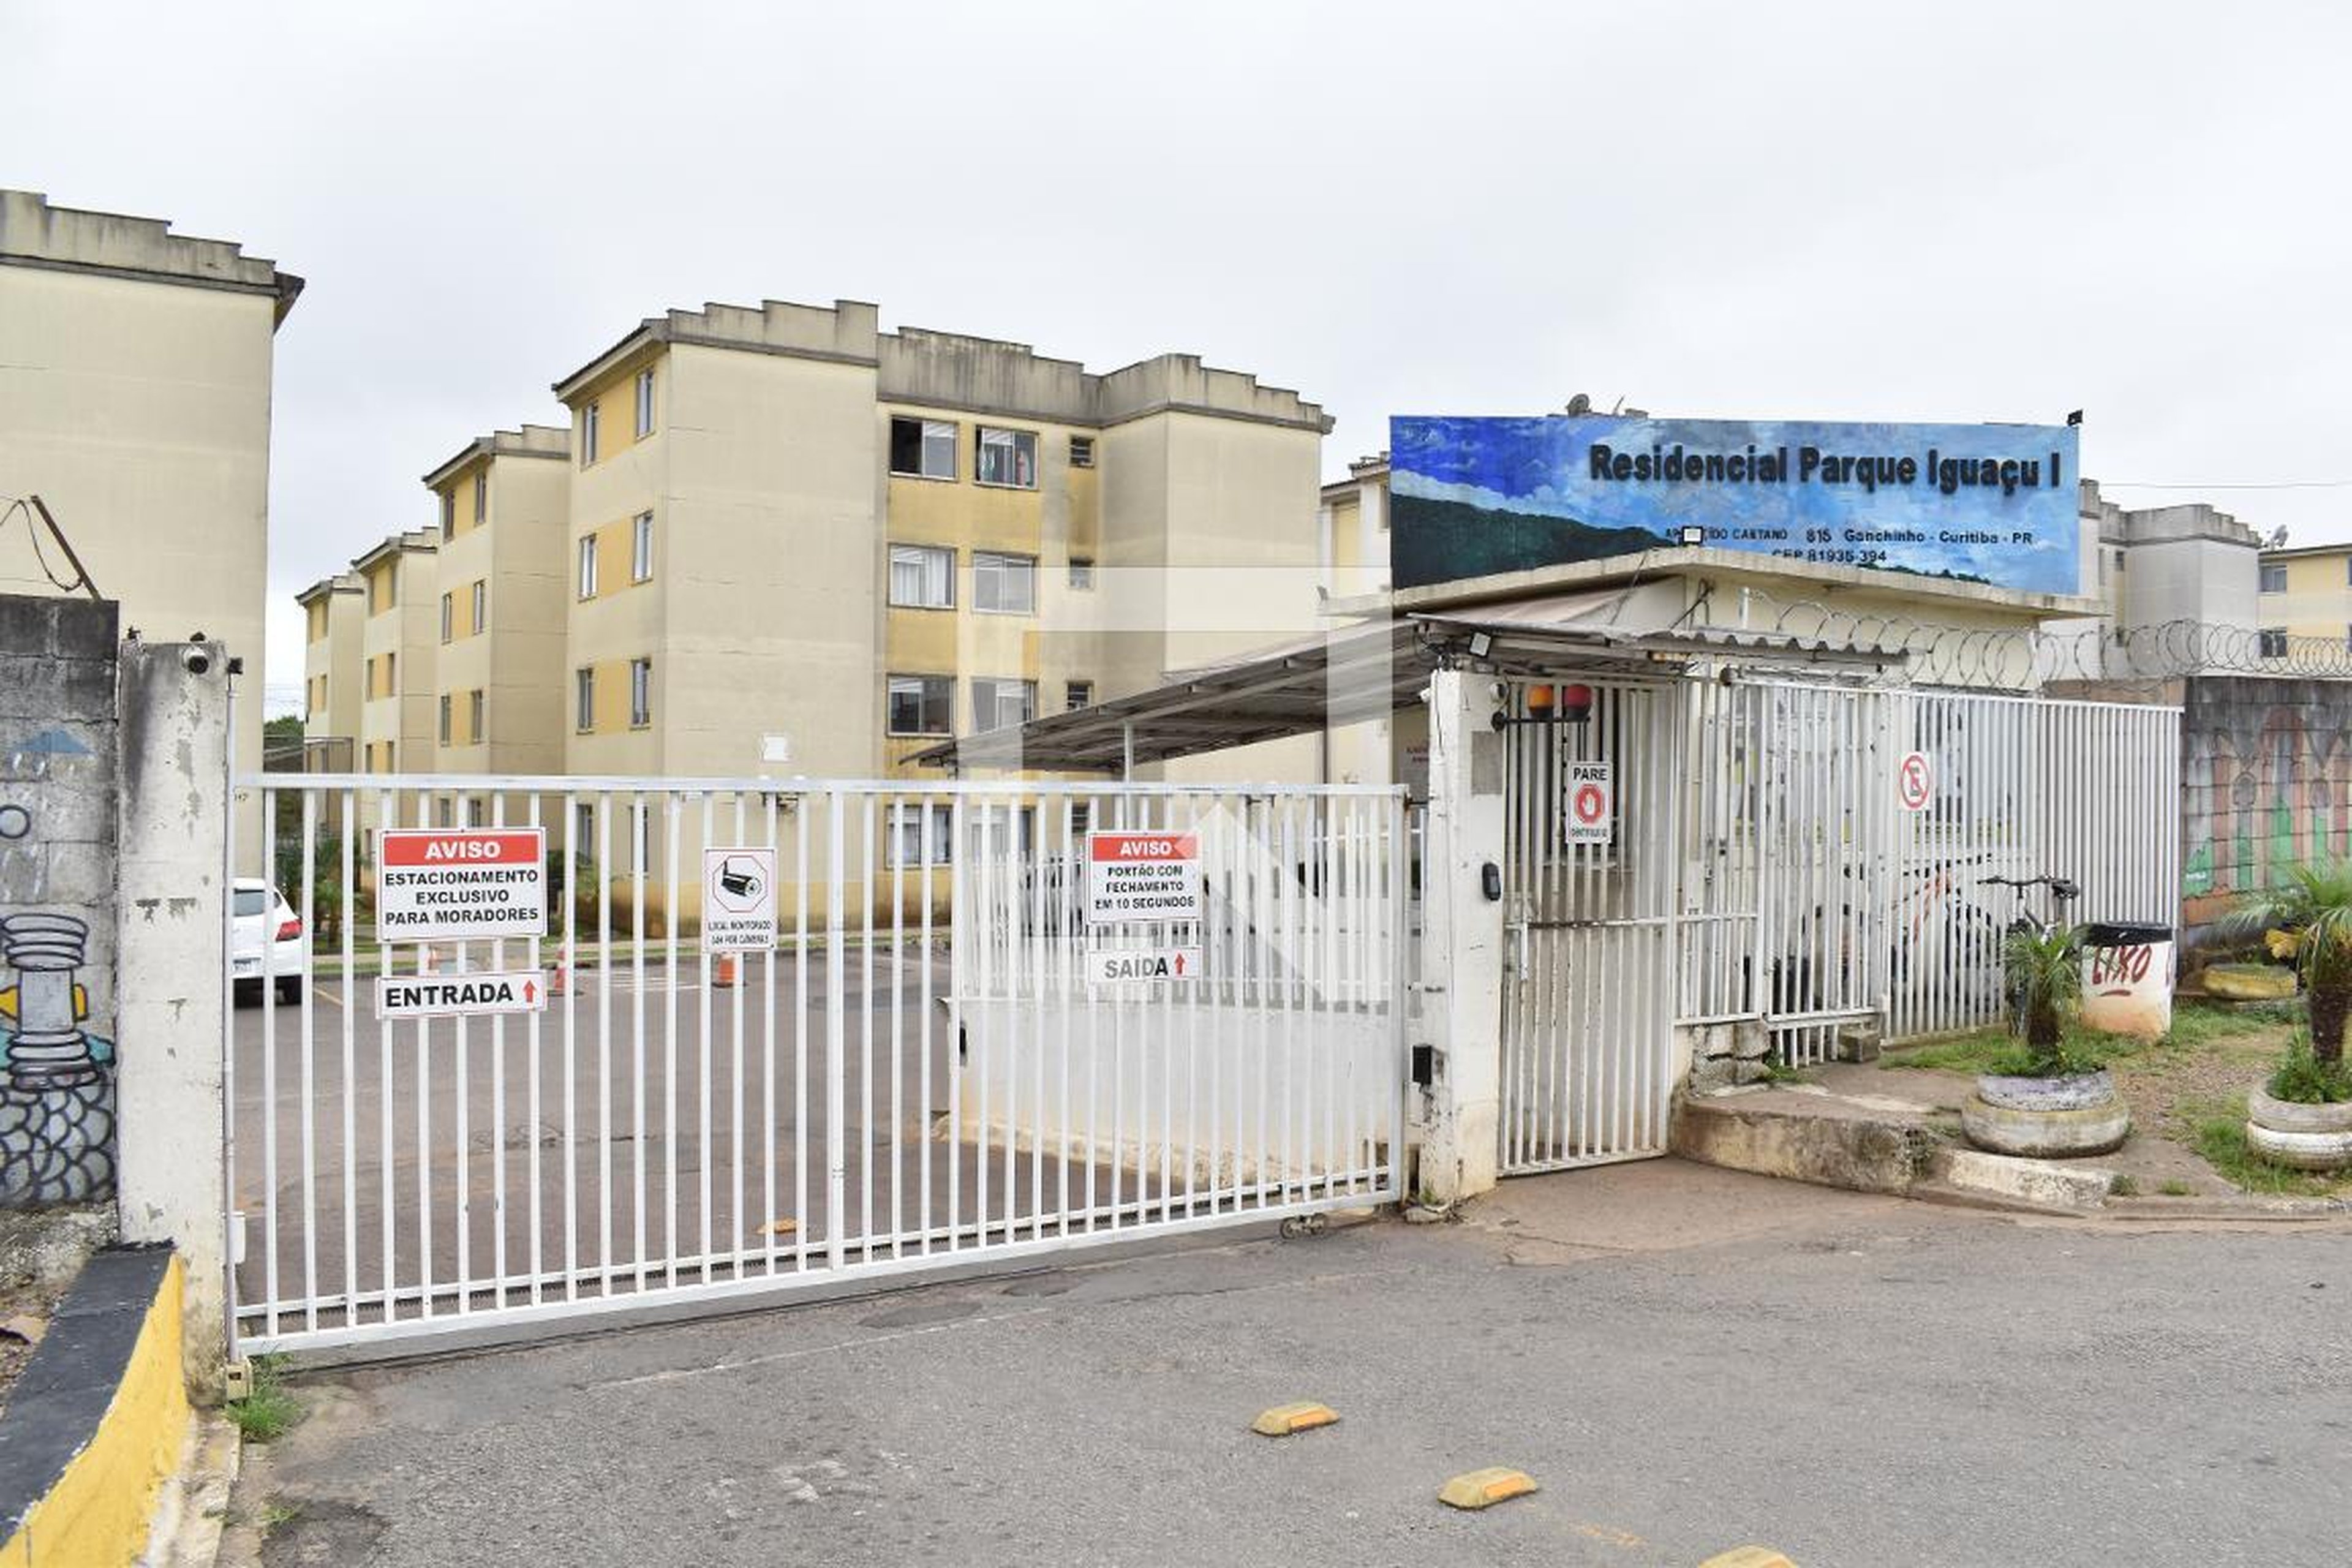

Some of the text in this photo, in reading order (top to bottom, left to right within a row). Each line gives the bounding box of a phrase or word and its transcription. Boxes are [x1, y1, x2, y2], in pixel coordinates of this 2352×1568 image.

[1589, 444, 2060, 496] Residencial Parque Iguaçu I
[1732, 527, 1788, 540] CAETANO
[1806, 528, 1833, 543] 815
[1844, 529, 1924, 543] Ganchinho
[1939, 530, 1999, 544] Curitiba
[2012, 532, 2034, 545] PR
[1573, 767, 1608, 781] PARE
[424, 840, 502, 859] AVISO
[1119, 841, 1173, 856] AVISO
[385, 870, 538, 886] ESTACIONAMENTO
[1107, 864, 1183, 877] PORTÃO COM
[1106, 881, 1185, 894] FECHAMENTO
[415, 889, 510, 905] EXCLUSIVO
[1095, 896, 1195, 910] EM 10 SEGUNDOS
[385, 907, 538, 925] PARA MORADORES
[1104, 953, 1169, 979] SAÍDA
[385, 982, 513, 1008] ENTRADA
